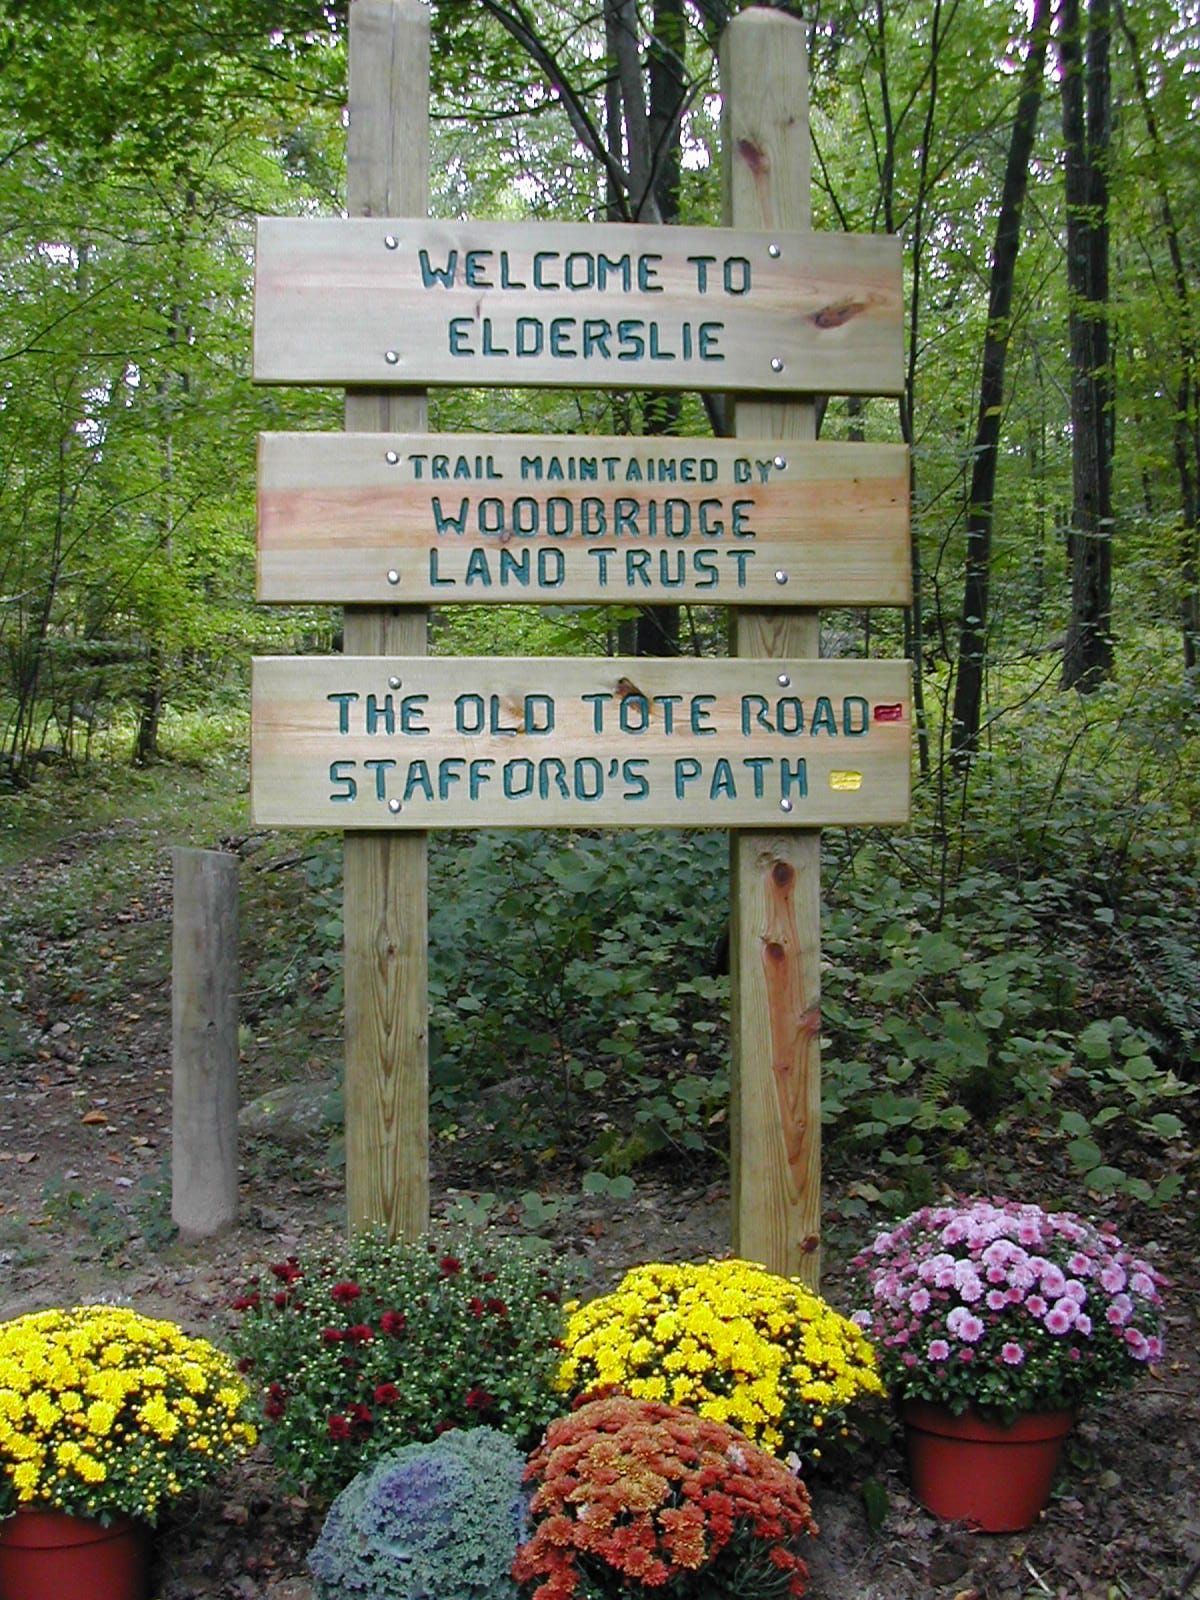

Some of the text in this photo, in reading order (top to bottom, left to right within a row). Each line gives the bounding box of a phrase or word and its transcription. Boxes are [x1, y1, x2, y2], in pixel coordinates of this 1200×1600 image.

[419, 249, 752, 295] WELCOME TO
[448, 316, 726, 362] ELDERSLIE
[408, 453, 503, 480] TRAIL
[734, 457, 773, 483] BY
[431, 496, 757, 539] WOODBRIDGE
[428, 547, 757, 589] LAND TRUST
[327, 692, 869, 738] THE OLD TOTE ROAD
[329, 757, 809, 802] STAFFORD'S PATH
